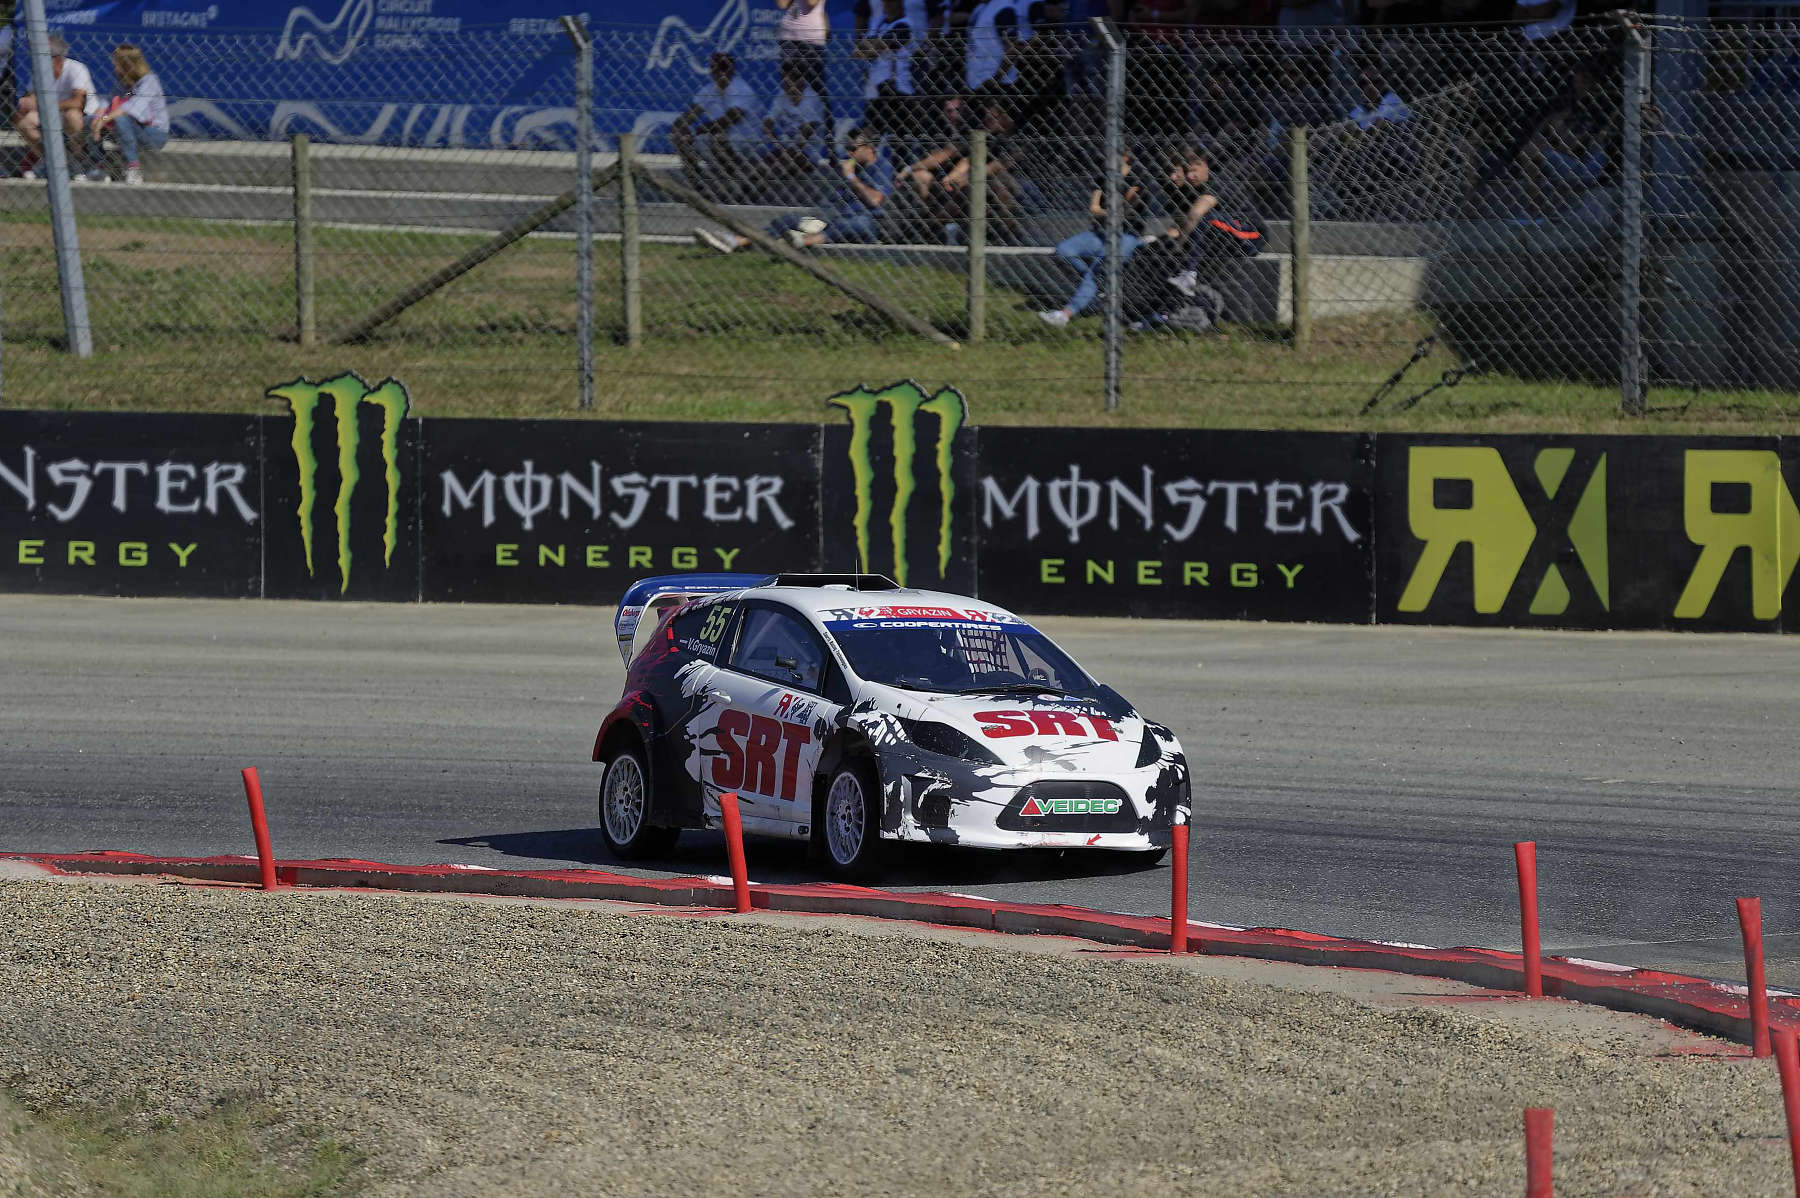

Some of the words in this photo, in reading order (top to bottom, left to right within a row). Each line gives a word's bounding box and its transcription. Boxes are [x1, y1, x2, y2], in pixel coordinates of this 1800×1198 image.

[440, 460, 795, 530] MONSTER
[981, 464, 1362, 543] MONSTER
[495, 543, 741, 569] ENERGY
[1041, 558, 1304, 589] ENERGY
[699, 605, 733, 643] 55
[897, 607, 952, 617] GRYAZIN
[973, 710, 1119, 742] SRT
[711, 708, 811, 802] SRT
